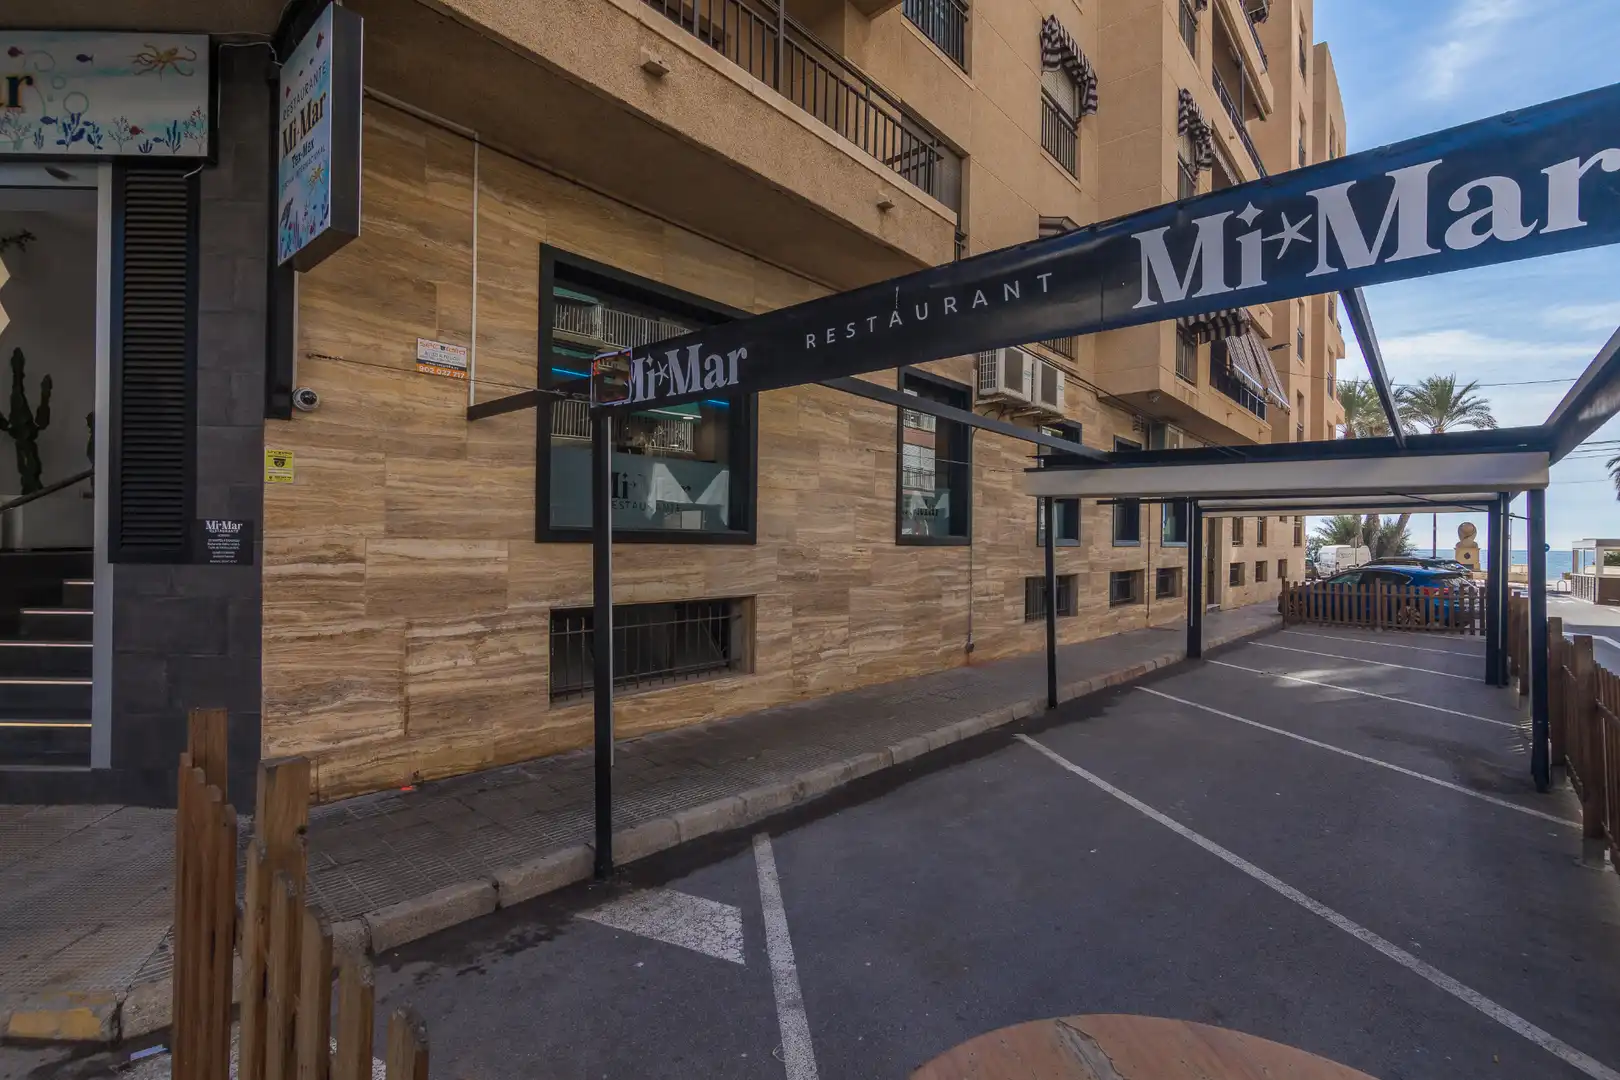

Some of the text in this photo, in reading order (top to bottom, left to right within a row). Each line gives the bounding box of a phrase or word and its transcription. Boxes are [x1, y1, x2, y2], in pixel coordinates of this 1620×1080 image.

[282, 60, 328, 121] RESTAURANTE
[806, 272, 1052, 348] RESTAURANT
[418, 365, 435, 374] 902
